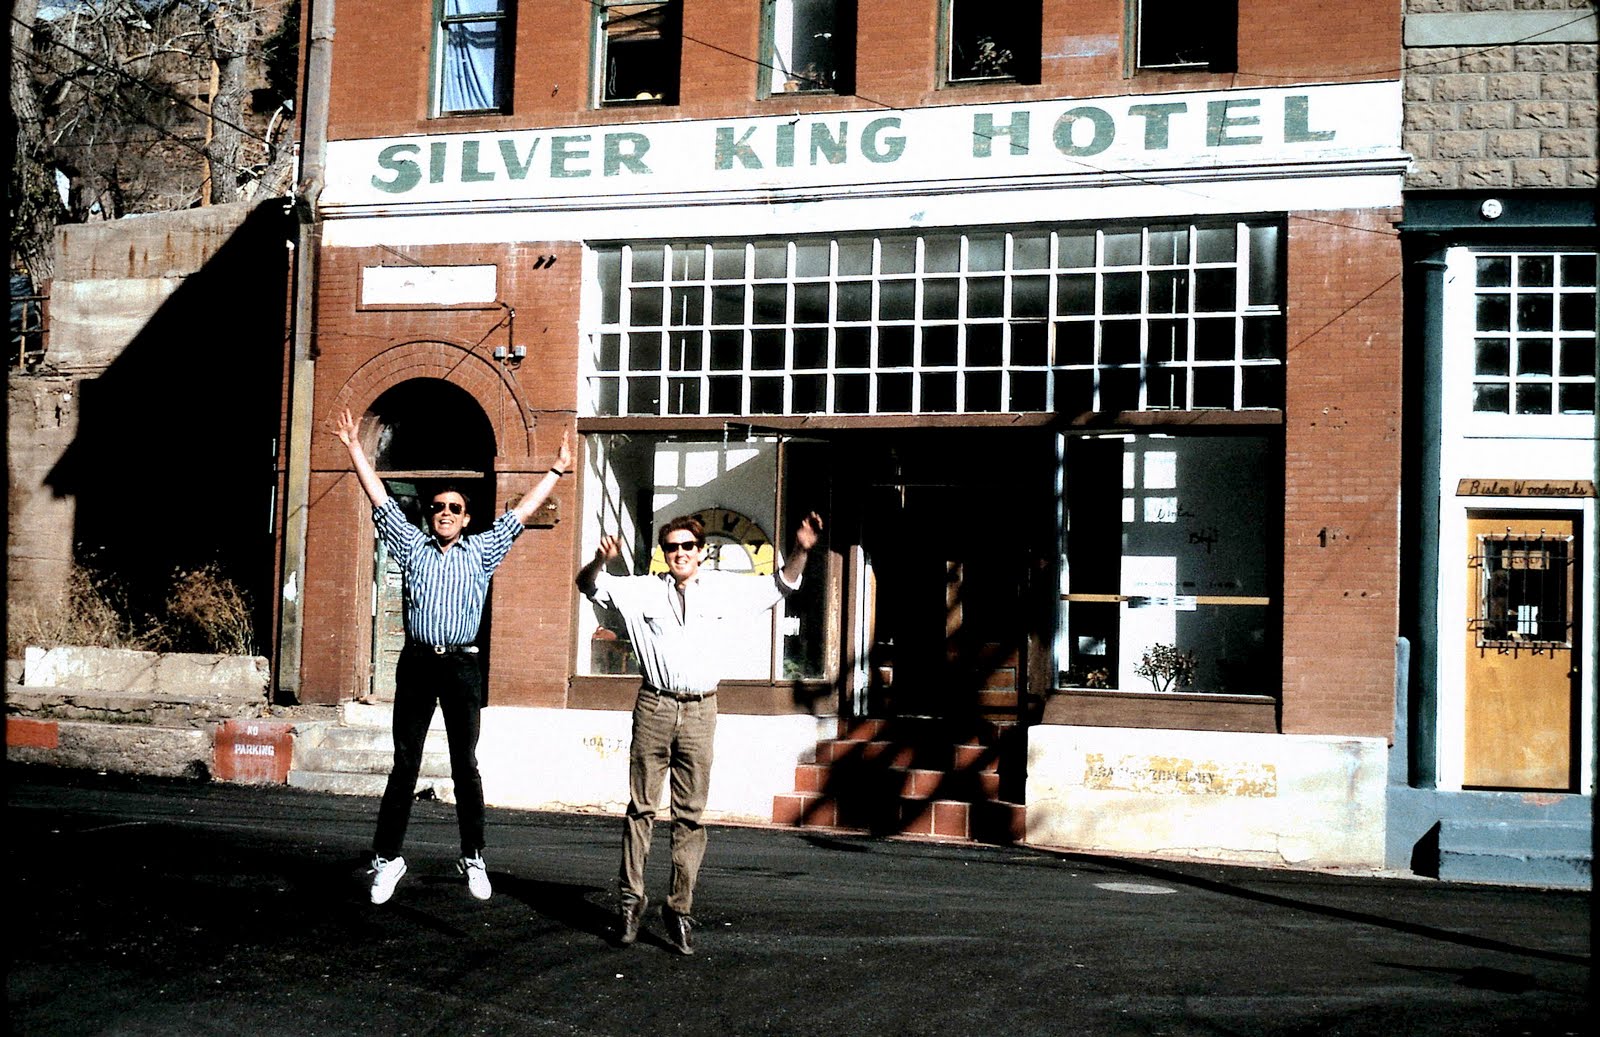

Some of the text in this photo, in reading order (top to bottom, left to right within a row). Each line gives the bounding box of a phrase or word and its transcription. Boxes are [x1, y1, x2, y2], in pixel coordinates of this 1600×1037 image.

[371, 95, 1337, 194] SILVER KING HOTEL
[246, 725, 259, 736] NO
[234, 743, 275, 756] PARKING
